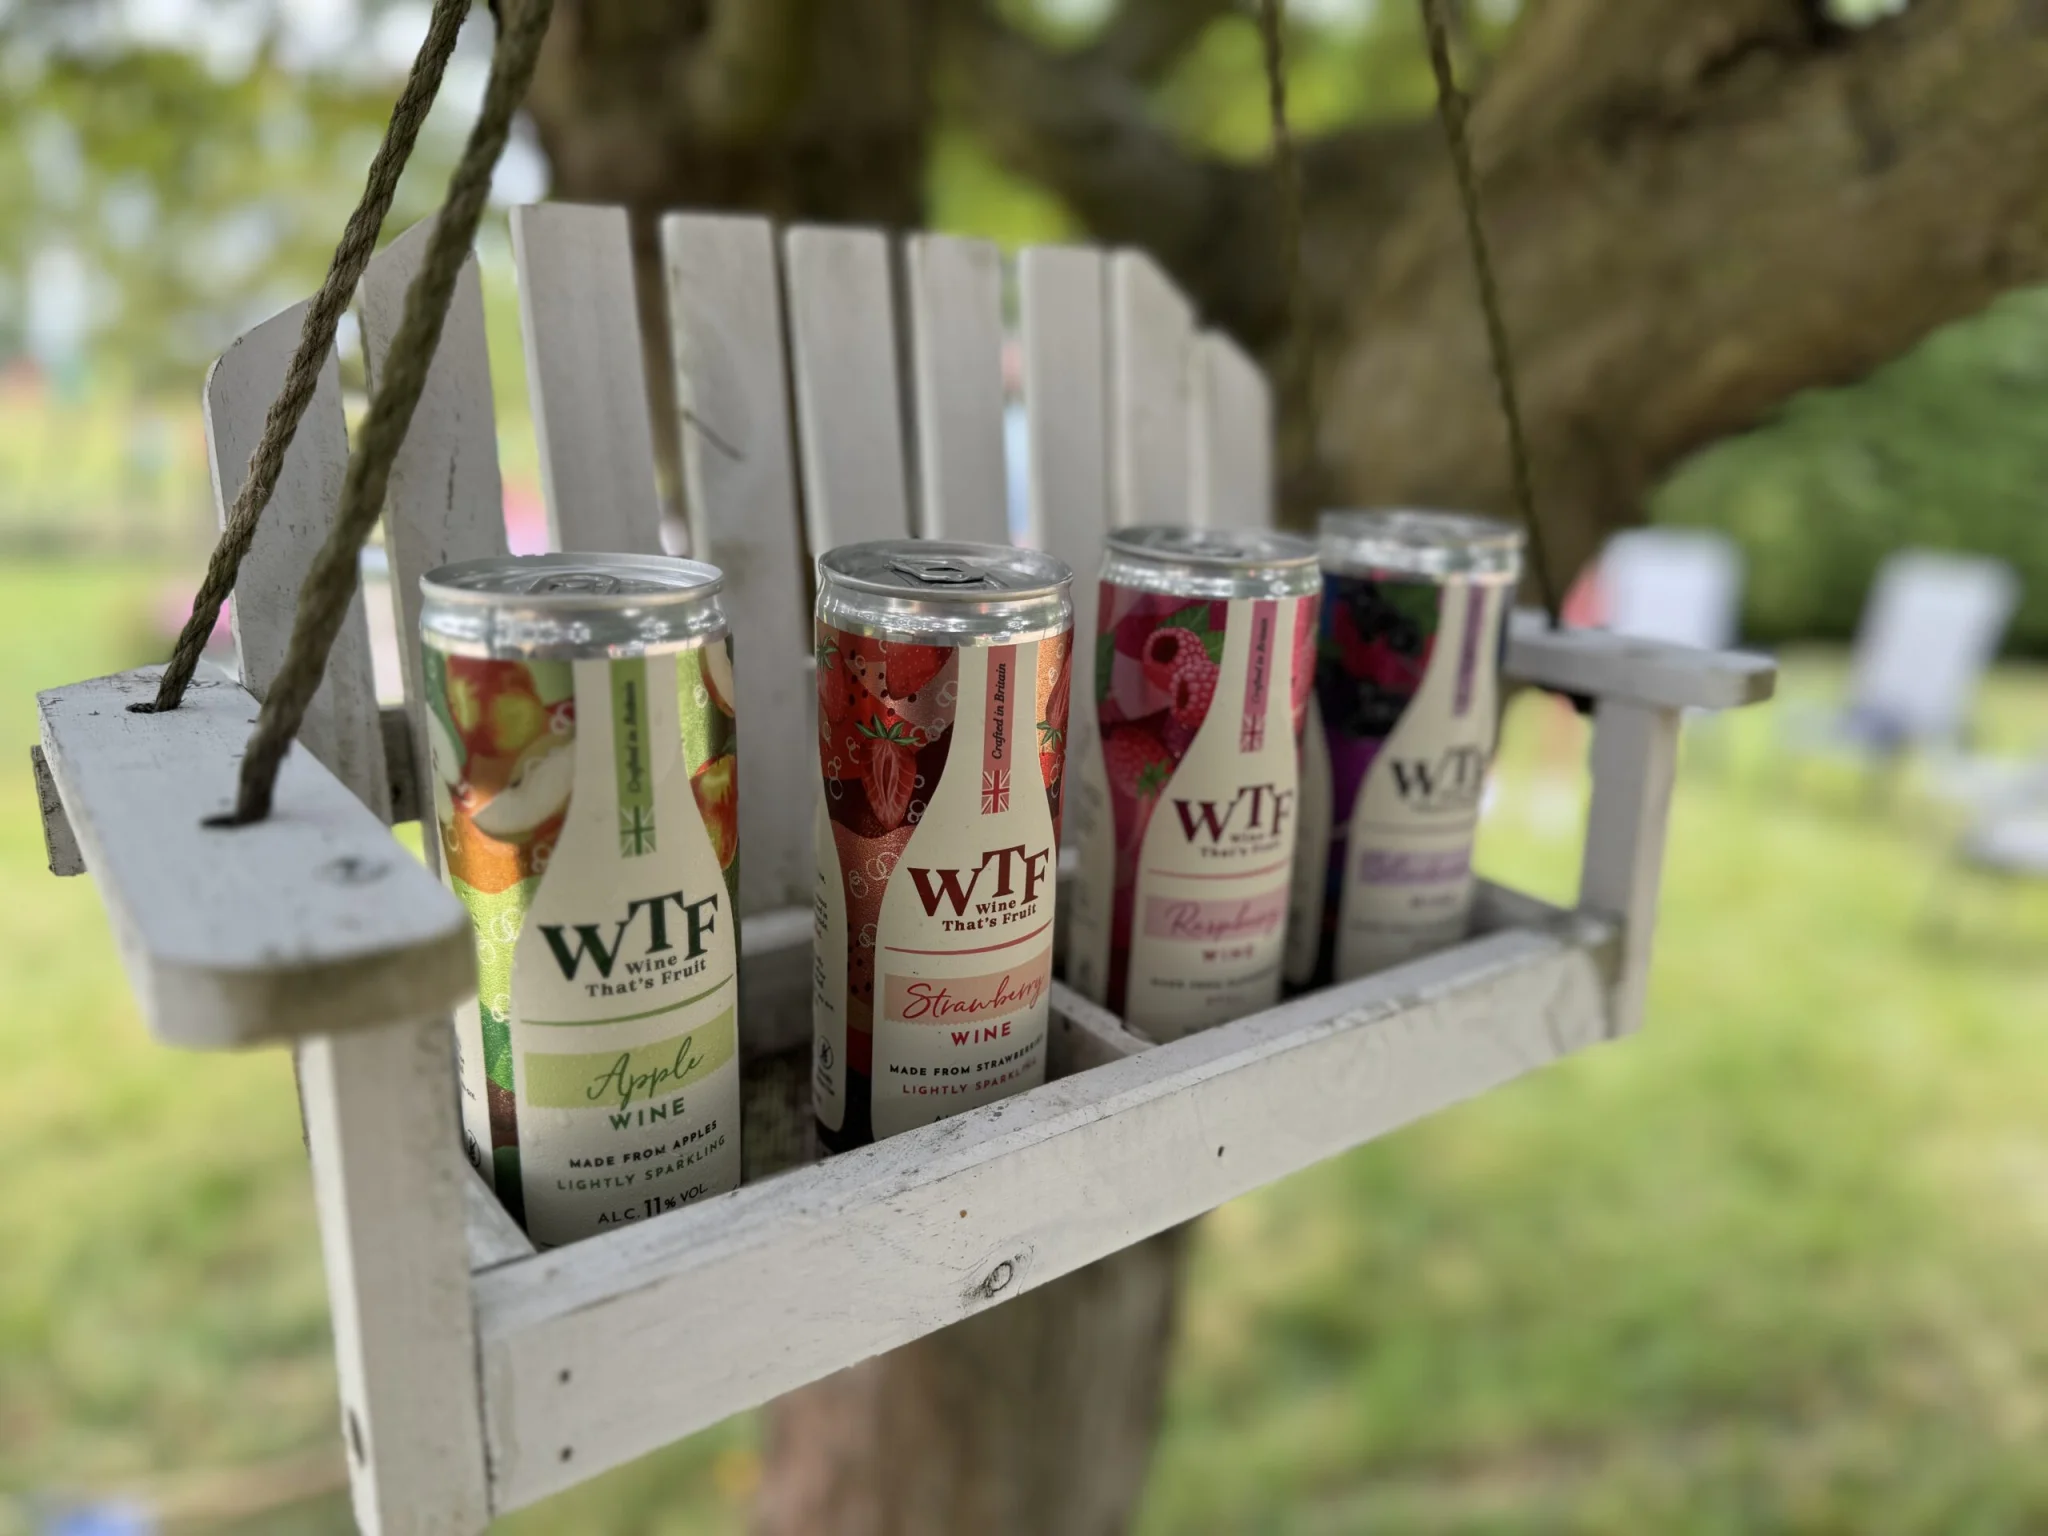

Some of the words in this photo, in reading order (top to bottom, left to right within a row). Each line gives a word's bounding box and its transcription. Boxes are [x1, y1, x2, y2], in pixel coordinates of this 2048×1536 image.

[993, 662, 1007, 704] Britain
[993, 705, 1005, 717] in
[991, 718, 1006, 760] Crafted
[1172, 783, 1294, 844] WTF
[906, 844, 1049, 917] WTF
[941, 917, 998, 932] That's
[1001, 903, 1037, 925] Fruit
[975, 899, 1016, 916] Wine
[536, 889, 718, 982] WTF
[584, 977, 655, 998] That's
[660, 958, 708, 986] Fruit
[624, 954, 678, 976] Wine
[902, 974, 1044, 1019] Strawberry
[951, 1021, 1012, 1047] WINE
[586, 1035, 705, 1112] Apple
[889, 1063, 927, 1077] MADE
[933, 1065, 970, 1077] FROM
[902, 1083, 968, 1096] LIGHTLY
[608, 1096, 686, 1131] WINE
[556, 1173, 636, 1191] LIGHTLY
[644, 1134, 726, 1181] SPARKLING
[569, 1154, 615, 1170] MADE
[622, 1144, 667, 1164] FROM
[672, 1119, 718, 1150] APPLES
[597, 1207, 641, 1226] ALC.
